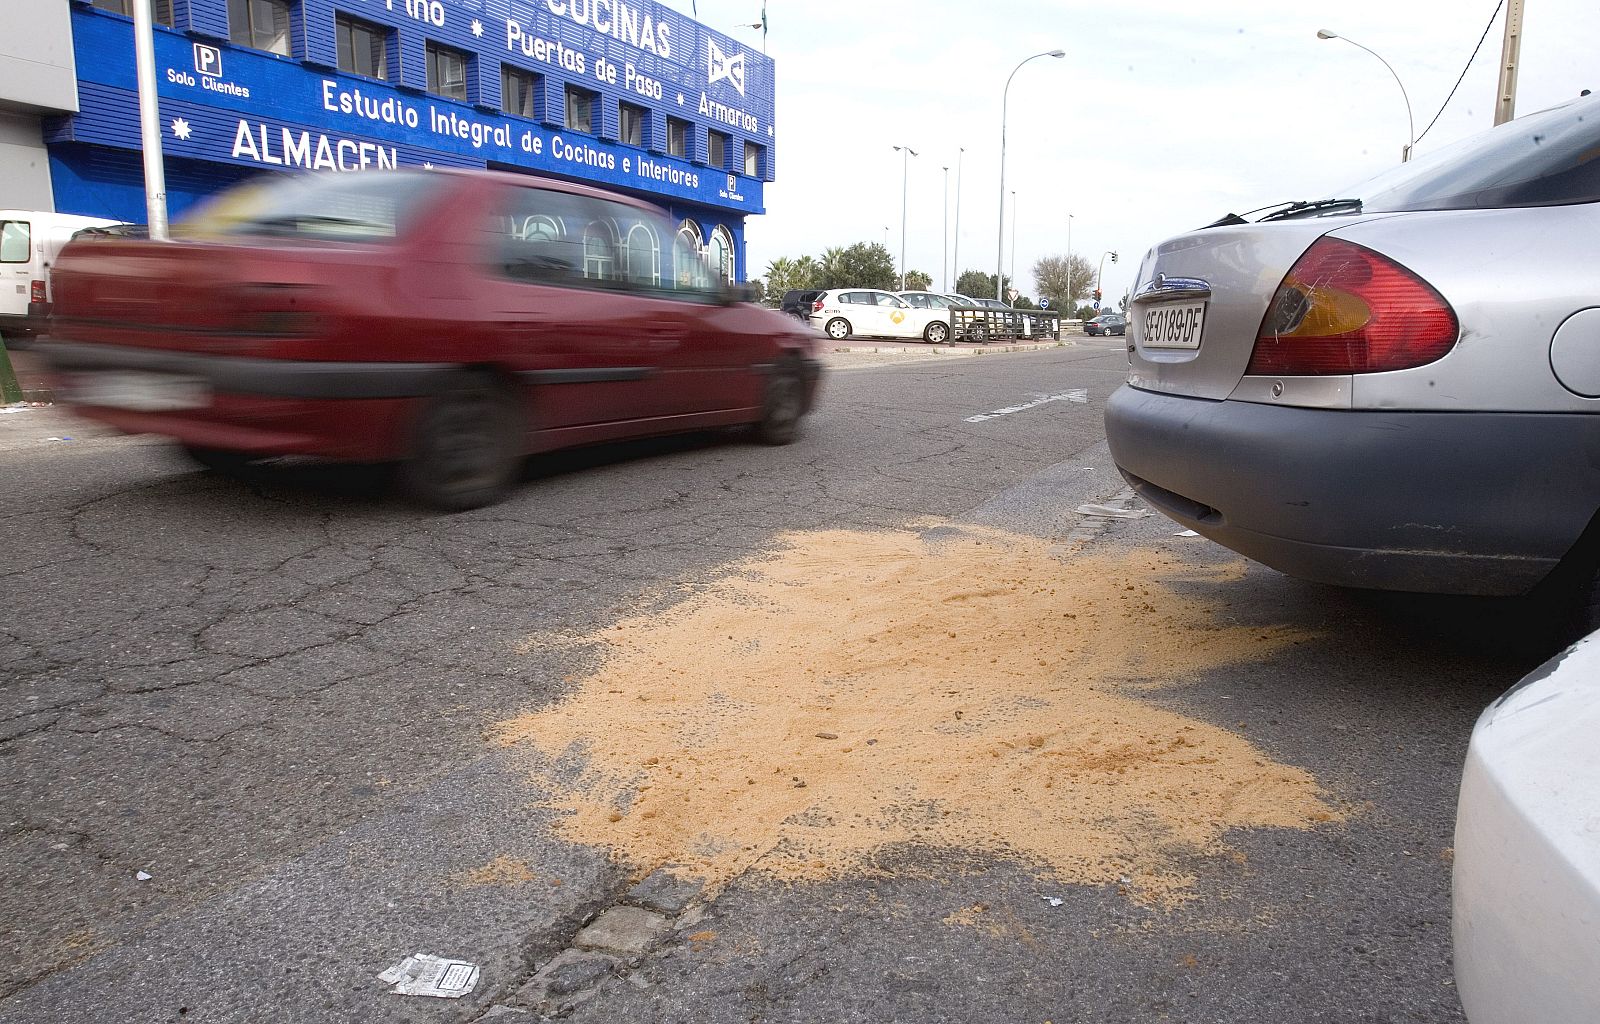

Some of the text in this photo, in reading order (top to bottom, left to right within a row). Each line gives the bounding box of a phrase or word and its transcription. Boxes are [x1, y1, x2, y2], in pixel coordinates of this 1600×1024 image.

[200, 47, 215, 72] P
[506, 18, 586, 74] Puertas
[595, 56, 617, 85] de
[625, 62, 663, 100] Paso
[699, 91, 758, 133] Armarios
[167, 68, 250, 98] Solo Clientes
[232, 119, 398, 173] ALMACEN
[322, 79, 699, 189] Estudio Integral de Cocinas e Interiores
[1144, 307, 1202, 343] SE-0189-DF
